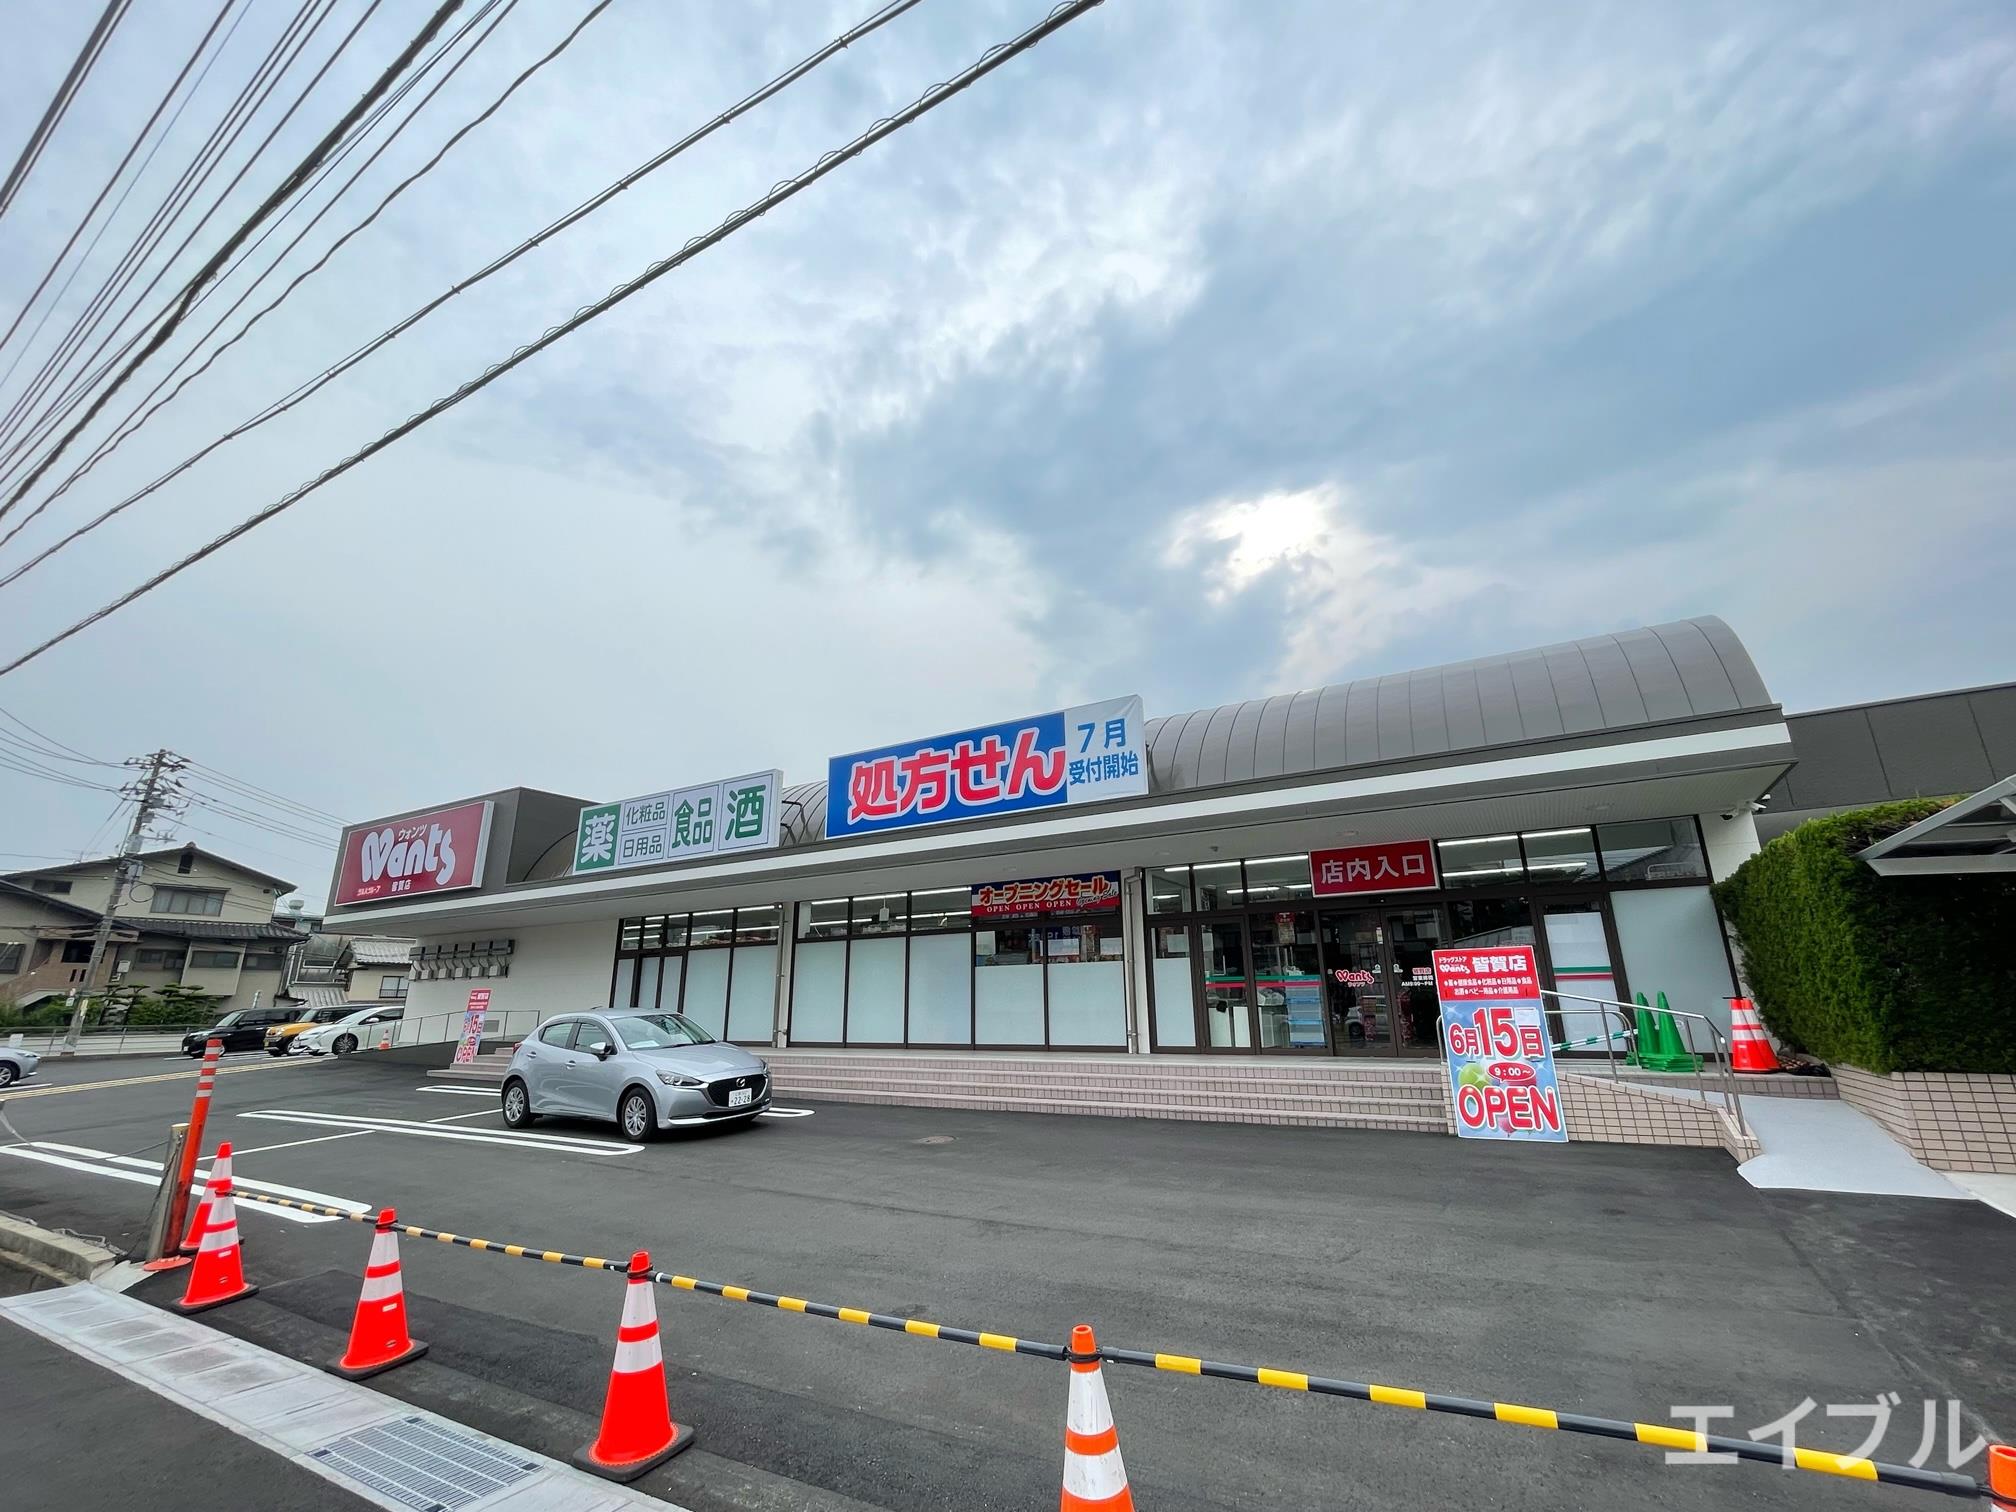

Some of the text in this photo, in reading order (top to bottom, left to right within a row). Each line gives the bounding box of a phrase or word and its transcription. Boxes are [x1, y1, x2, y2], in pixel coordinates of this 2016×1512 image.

[1077, 718, 1127, 753] 7月
[849, 729, 1066, 823] 処方せん
[1069, 750, 1139, 786] 受付開始
[626, 801, 666, 826] 化粧品
[671, 797, 713, 849] 食品
[725, 784, 766, 841] 酒
[398, 823, 428, 841] ウォンツ
[580, 812, 616, 864] 薬
[623, 834, 662, 858] 日用品
[361, 823, 456, 886] Wants
[1321, 854, 1425, 884] 店内入口
[979, 875, 1110, 906] オープニングセール
[986, 899, 1072, 913] OPEN OPEN OPEN
[1335, 969, 1374, 985] Wants
[1439, 964, 1470, 974] Wants
[1472, 955, 1527, 973] 皆賀店
[1457, 1084, 1561, 1132] OPEN
